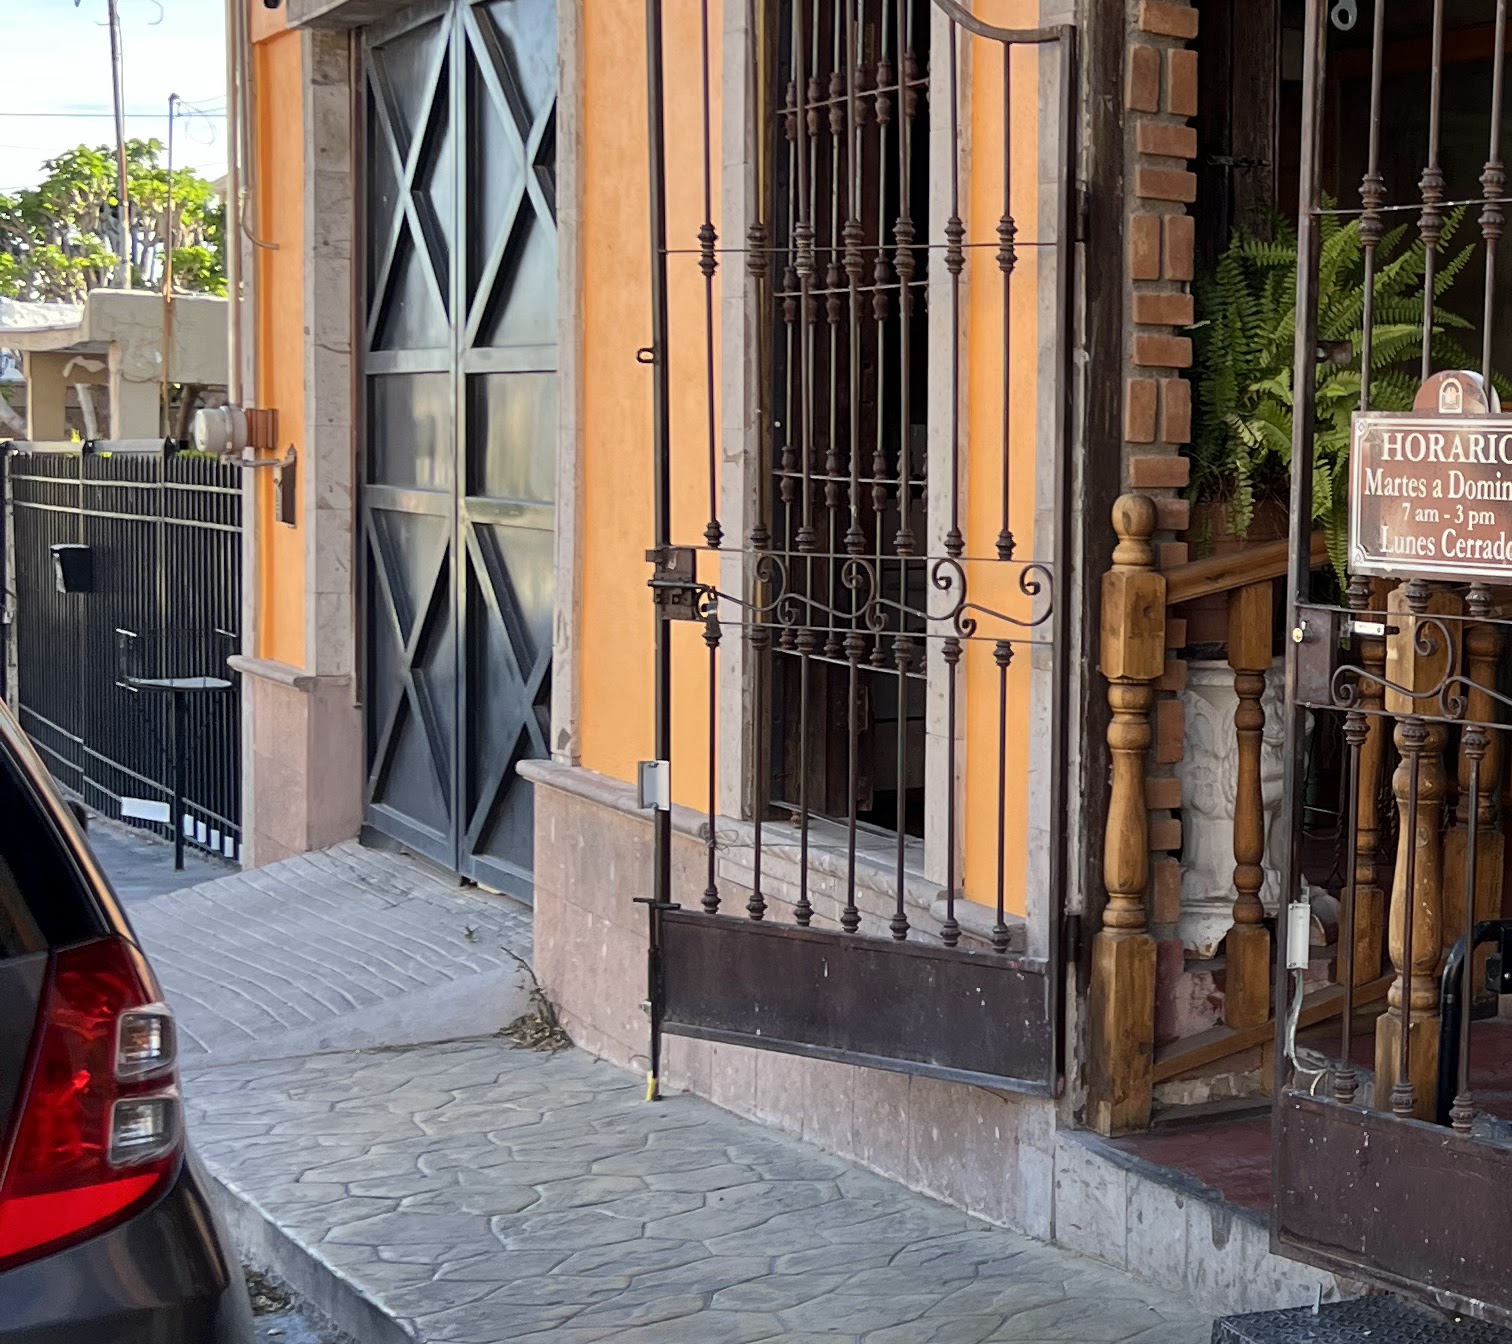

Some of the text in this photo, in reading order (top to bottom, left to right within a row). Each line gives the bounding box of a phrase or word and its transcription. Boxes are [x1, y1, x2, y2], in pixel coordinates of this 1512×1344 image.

[1364, 467, 1427, 498] Martes
[1432, 480, 1443, 499] a
[1402, 502, 1411, 522] 7
[1415, 507, 1440, 523] am
[1454, 504, 1464, 524] 3
[1468, 508, 1496, 531] pm
[1380, 524, 1435, 557] Lunes
